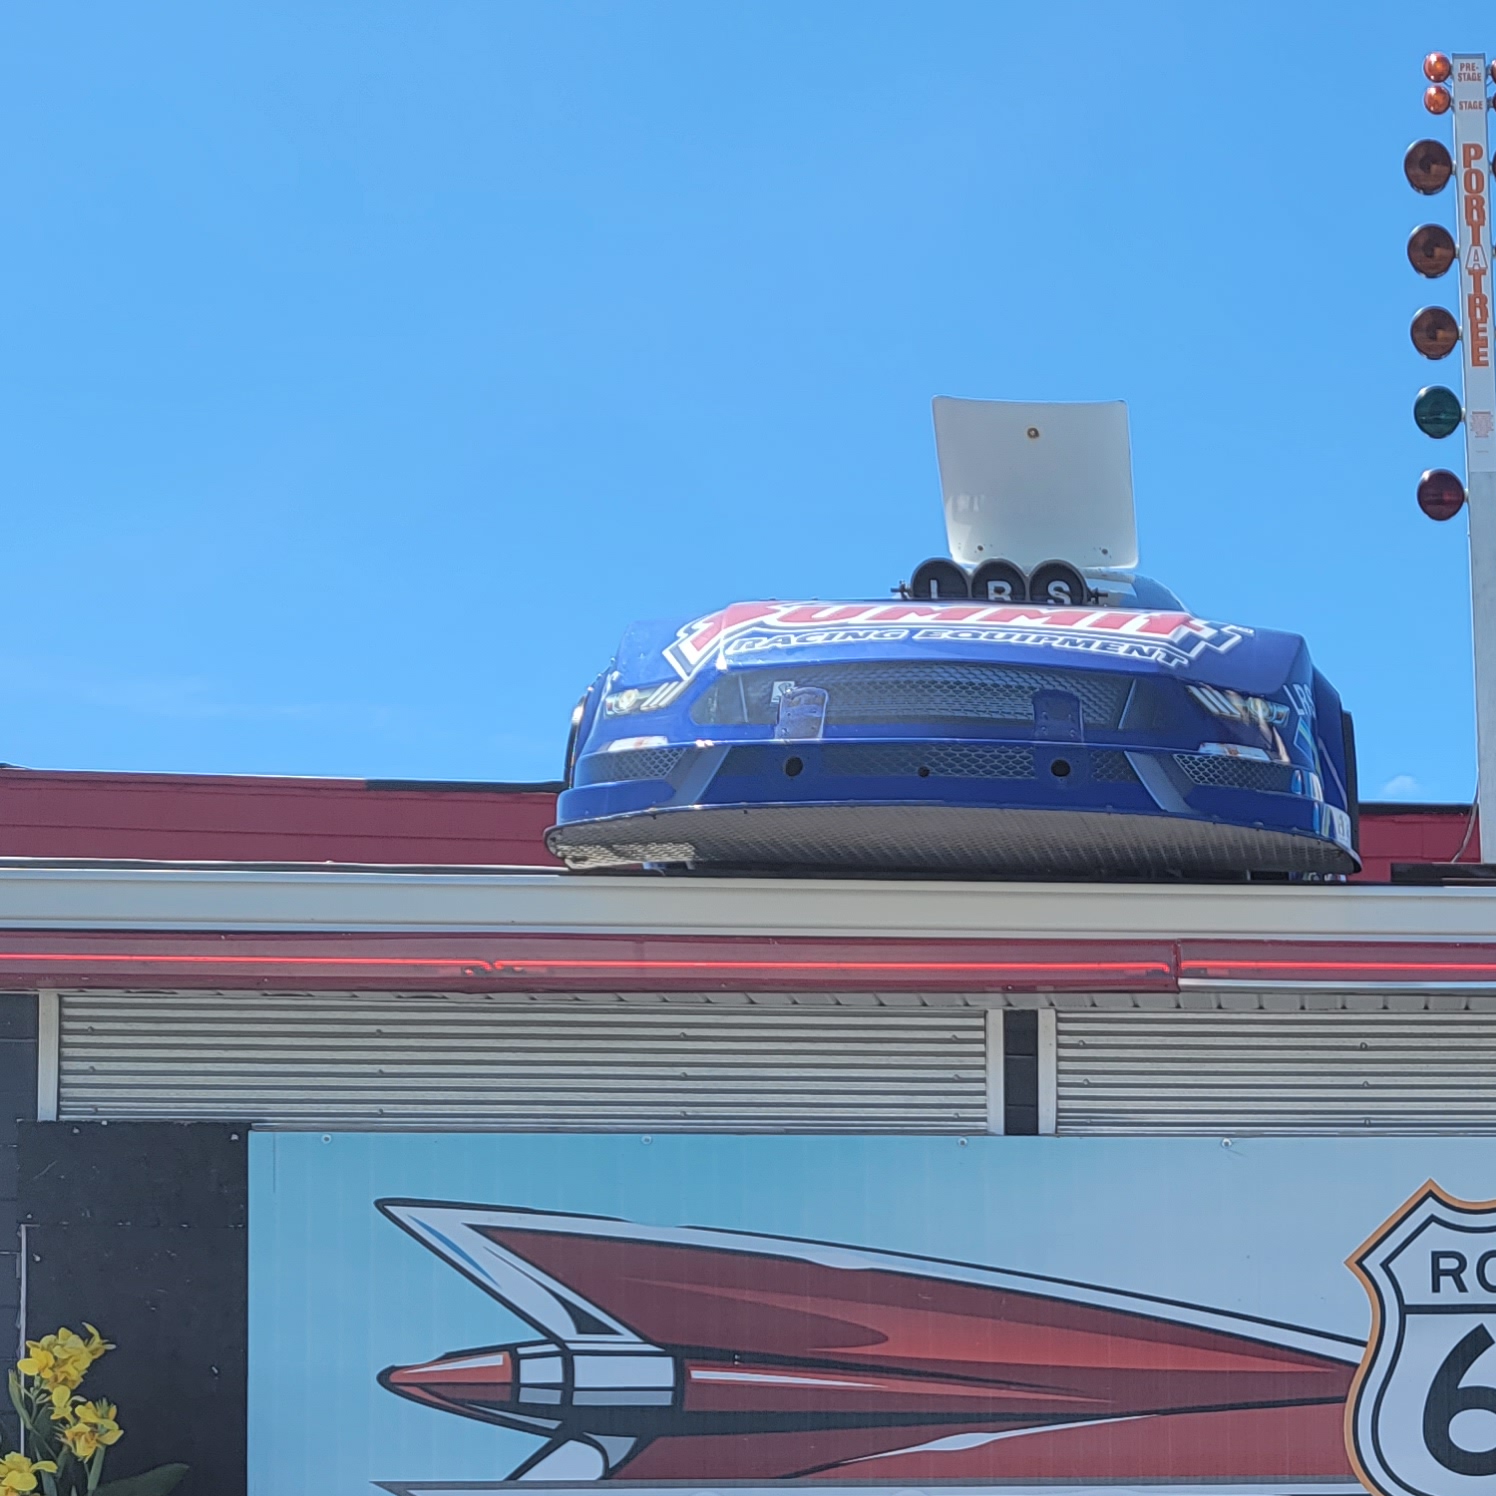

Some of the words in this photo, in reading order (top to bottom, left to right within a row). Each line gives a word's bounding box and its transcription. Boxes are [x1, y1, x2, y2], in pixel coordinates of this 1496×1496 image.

[1459, 62, 1479, 72] PRE-
[1457, 72, 1482, 82] STAGE
[1458, 100, 1483, 110] STAGE
[676, 598, 1205, 653] SUMMIT
[727, 628, 908, 653] RACING
[912, 628, 1190, 668] EQUIPMENT
